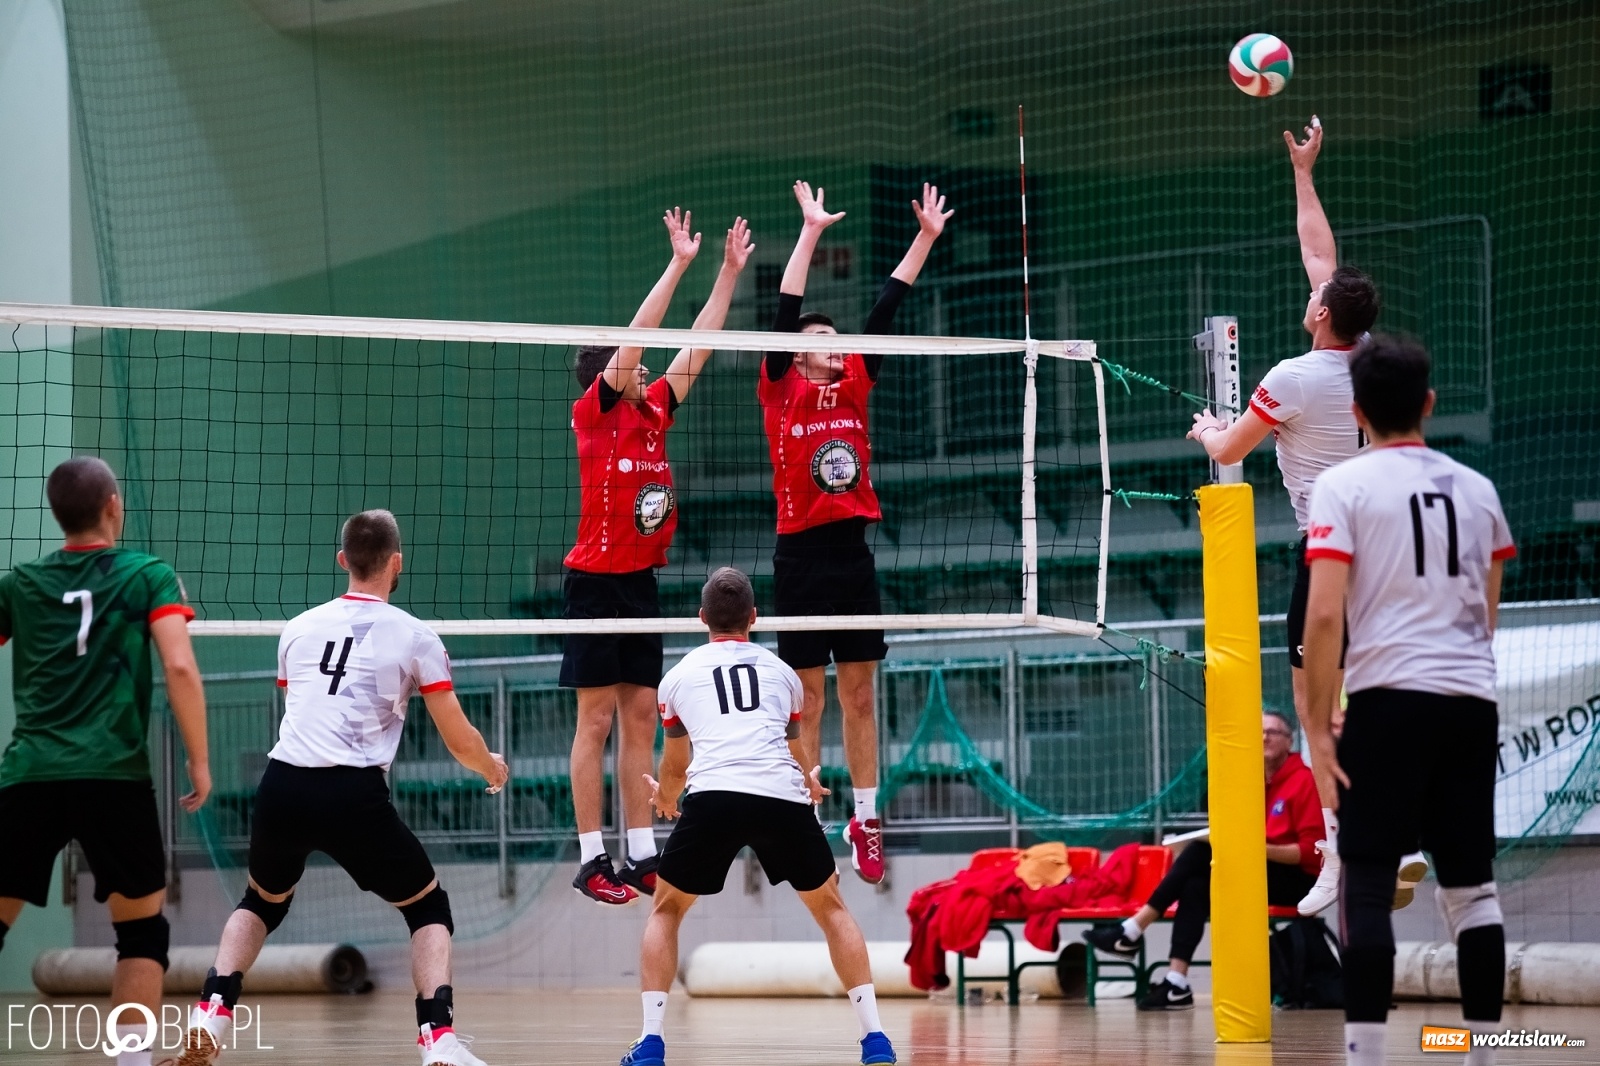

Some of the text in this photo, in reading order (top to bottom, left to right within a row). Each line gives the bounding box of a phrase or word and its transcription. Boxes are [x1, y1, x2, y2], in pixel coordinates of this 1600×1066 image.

[816, 383, 841, 410] 15
[807, 421, 826, 436] JSW
[601, 521, 609, 552] KLUB
[1409, 492, 1459, 576] 17
[62, 589, 93, 656] 7
[319, 637, 354, 695] 4
[712, 663, 760, 715] 10
[1512, 727, 1541, 762] W
